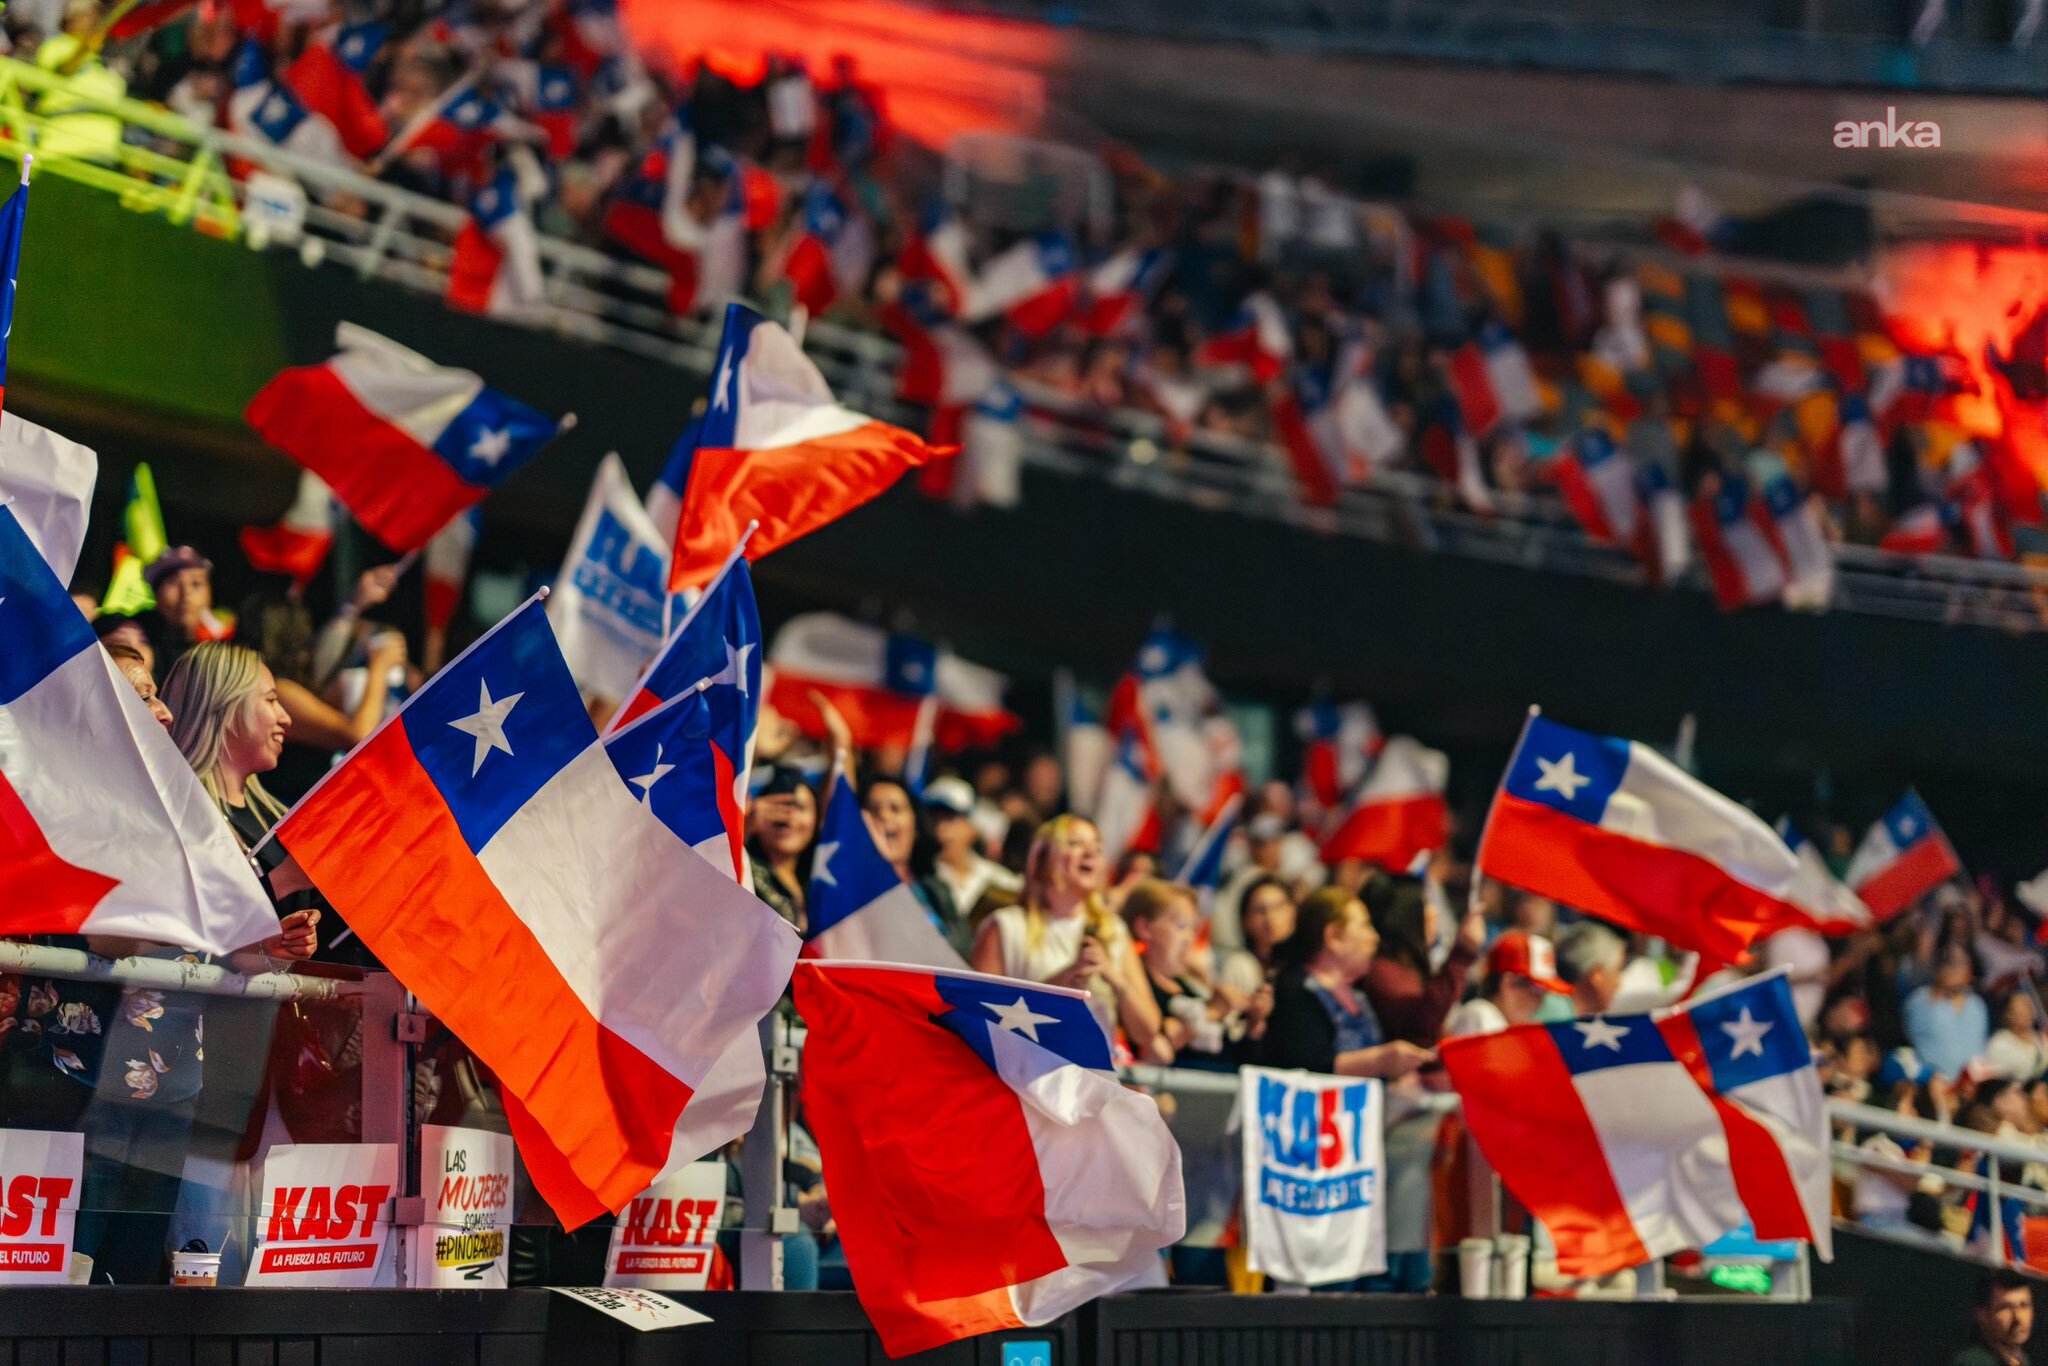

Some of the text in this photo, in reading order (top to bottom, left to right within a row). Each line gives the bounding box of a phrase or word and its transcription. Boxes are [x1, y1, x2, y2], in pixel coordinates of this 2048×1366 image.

[446, 1149, 467, 1173] LAS
[438, 1173, 510, 1212] MUJERES
[266, 1185, 390, 1242] KAST
[622, 1198, 718, 1247] KAST
[11, 1250, 50, 1264] FUTURO
[272, 1251, 365, 1267] LA FUERZA DEL FUTURO
